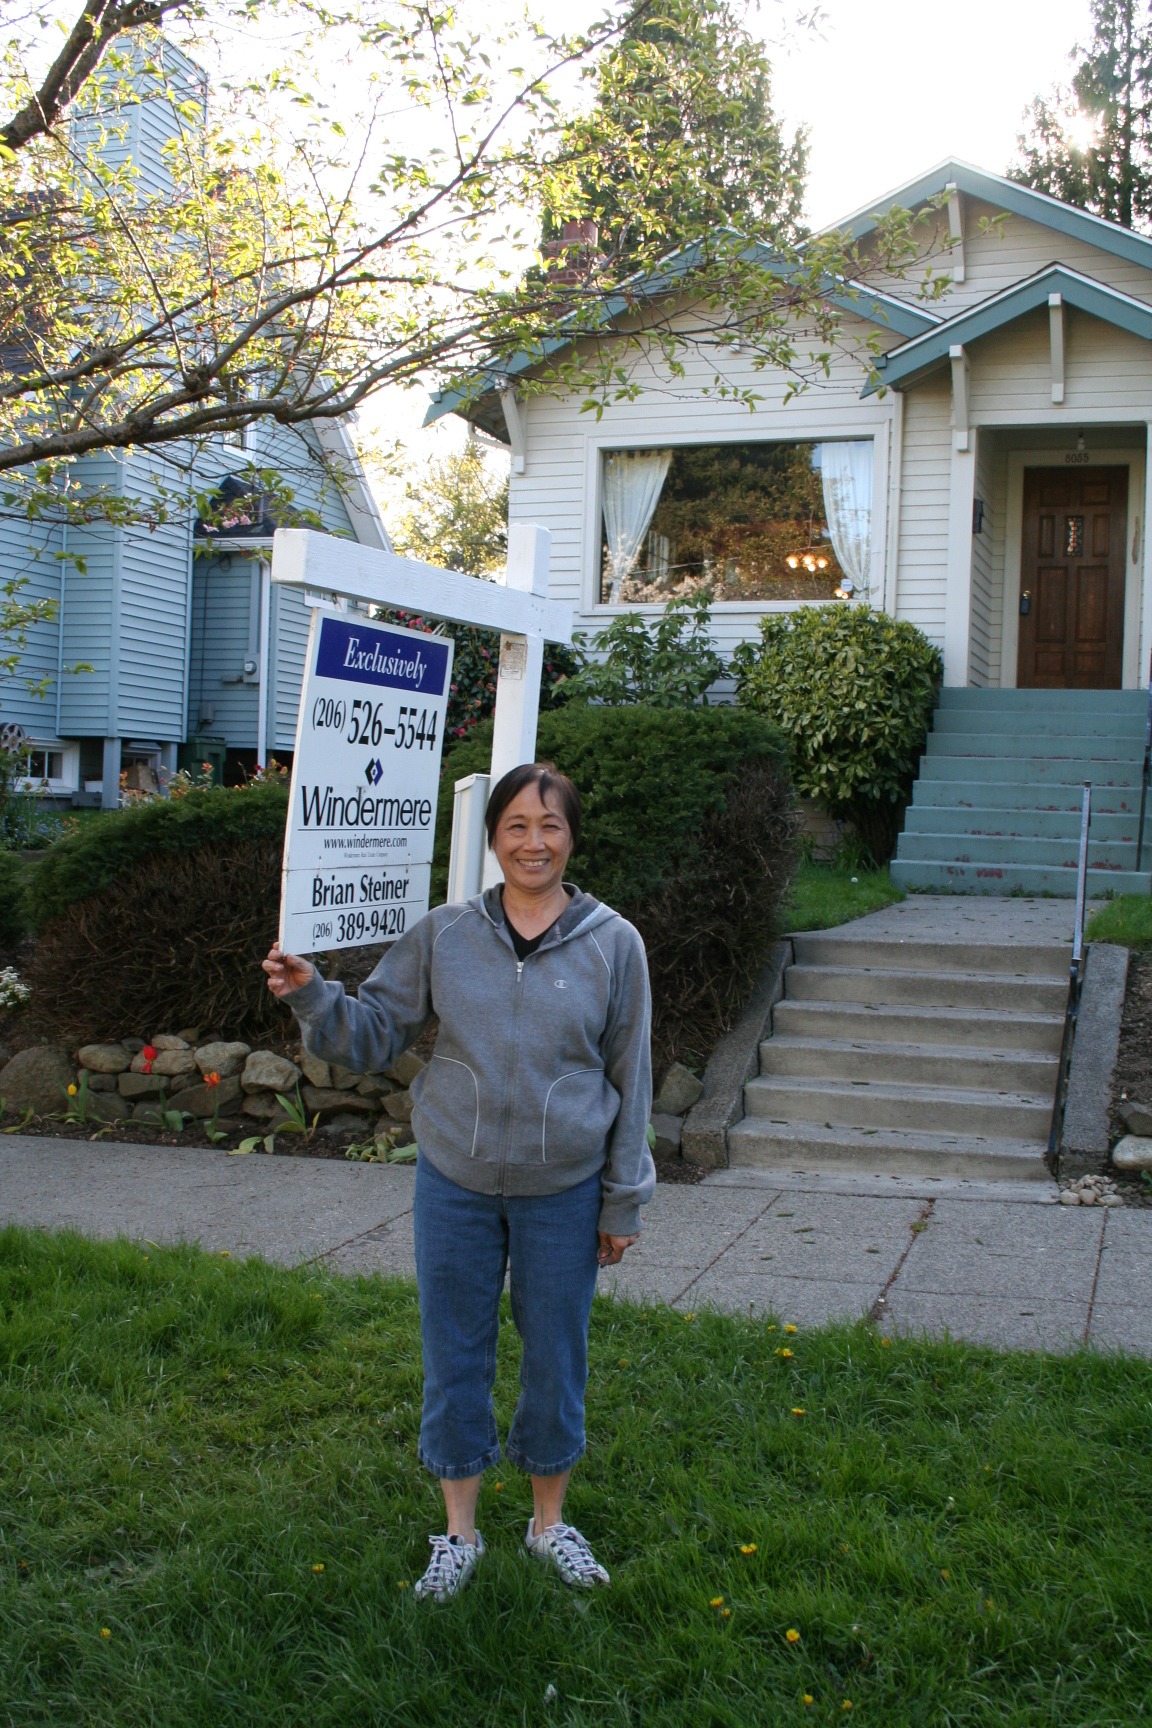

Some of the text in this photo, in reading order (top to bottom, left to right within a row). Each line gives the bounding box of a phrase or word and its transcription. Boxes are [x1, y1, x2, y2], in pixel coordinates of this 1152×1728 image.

[343, 637, 427, 688] Exclusively
[312, 697, 438, 751] (206) 526-5544
[301, 785, 432, 827] Windermere
[324, 834, 408, 849] www.windermere.com
[312, 871, 410, 907] Brian Steiner
[312, 907, 405, 942] (206) 389-9420
